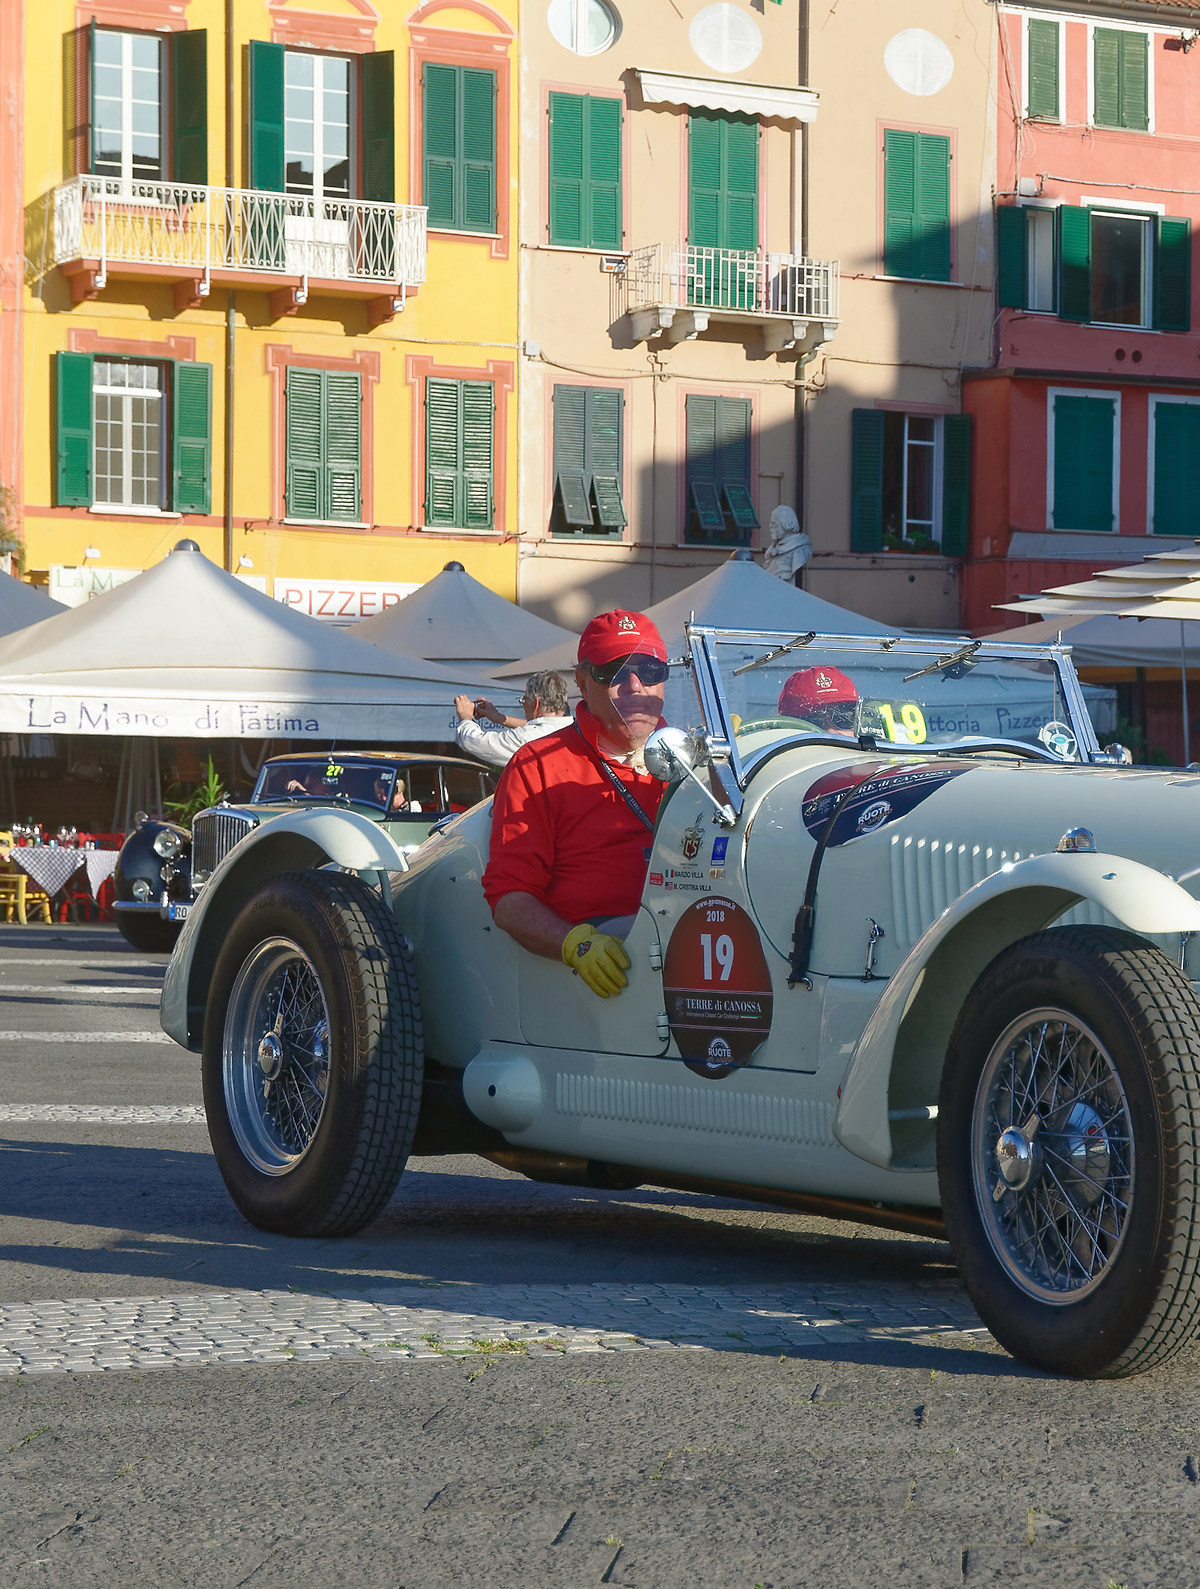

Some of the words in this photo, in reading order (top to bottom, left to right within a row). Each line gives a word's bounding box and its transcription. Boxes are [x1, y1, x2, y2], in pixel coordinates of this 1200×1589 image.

[56, 569, 84, 588] La
[285, 588, 408, 617] PIZZER
[28, 698, 67, 728] La
[78, 702, 169, 731] Mano
[195, 704, 219, 730] di
[239, 704, 320, 734] Fatima
[878, 704, 927, 744] 19
[926, 714, 980, 733] ttoria
[326, 764, 341, 777] 27
[692, 871, 704, 879] VILLA
[679, 883, 699, 891] CRISTINA
[699, 884, 712, 892] VILLA
[706, 910, 725, 922] 2018
[701, 933, 735, 981] 19
[685, 998, 713, 1010] TERRE
[714, 1000, 722, 1010] di
[724, 1001, 762, 1013] CANOSSA
[708, 1047, 732, 1058] RUOTE
